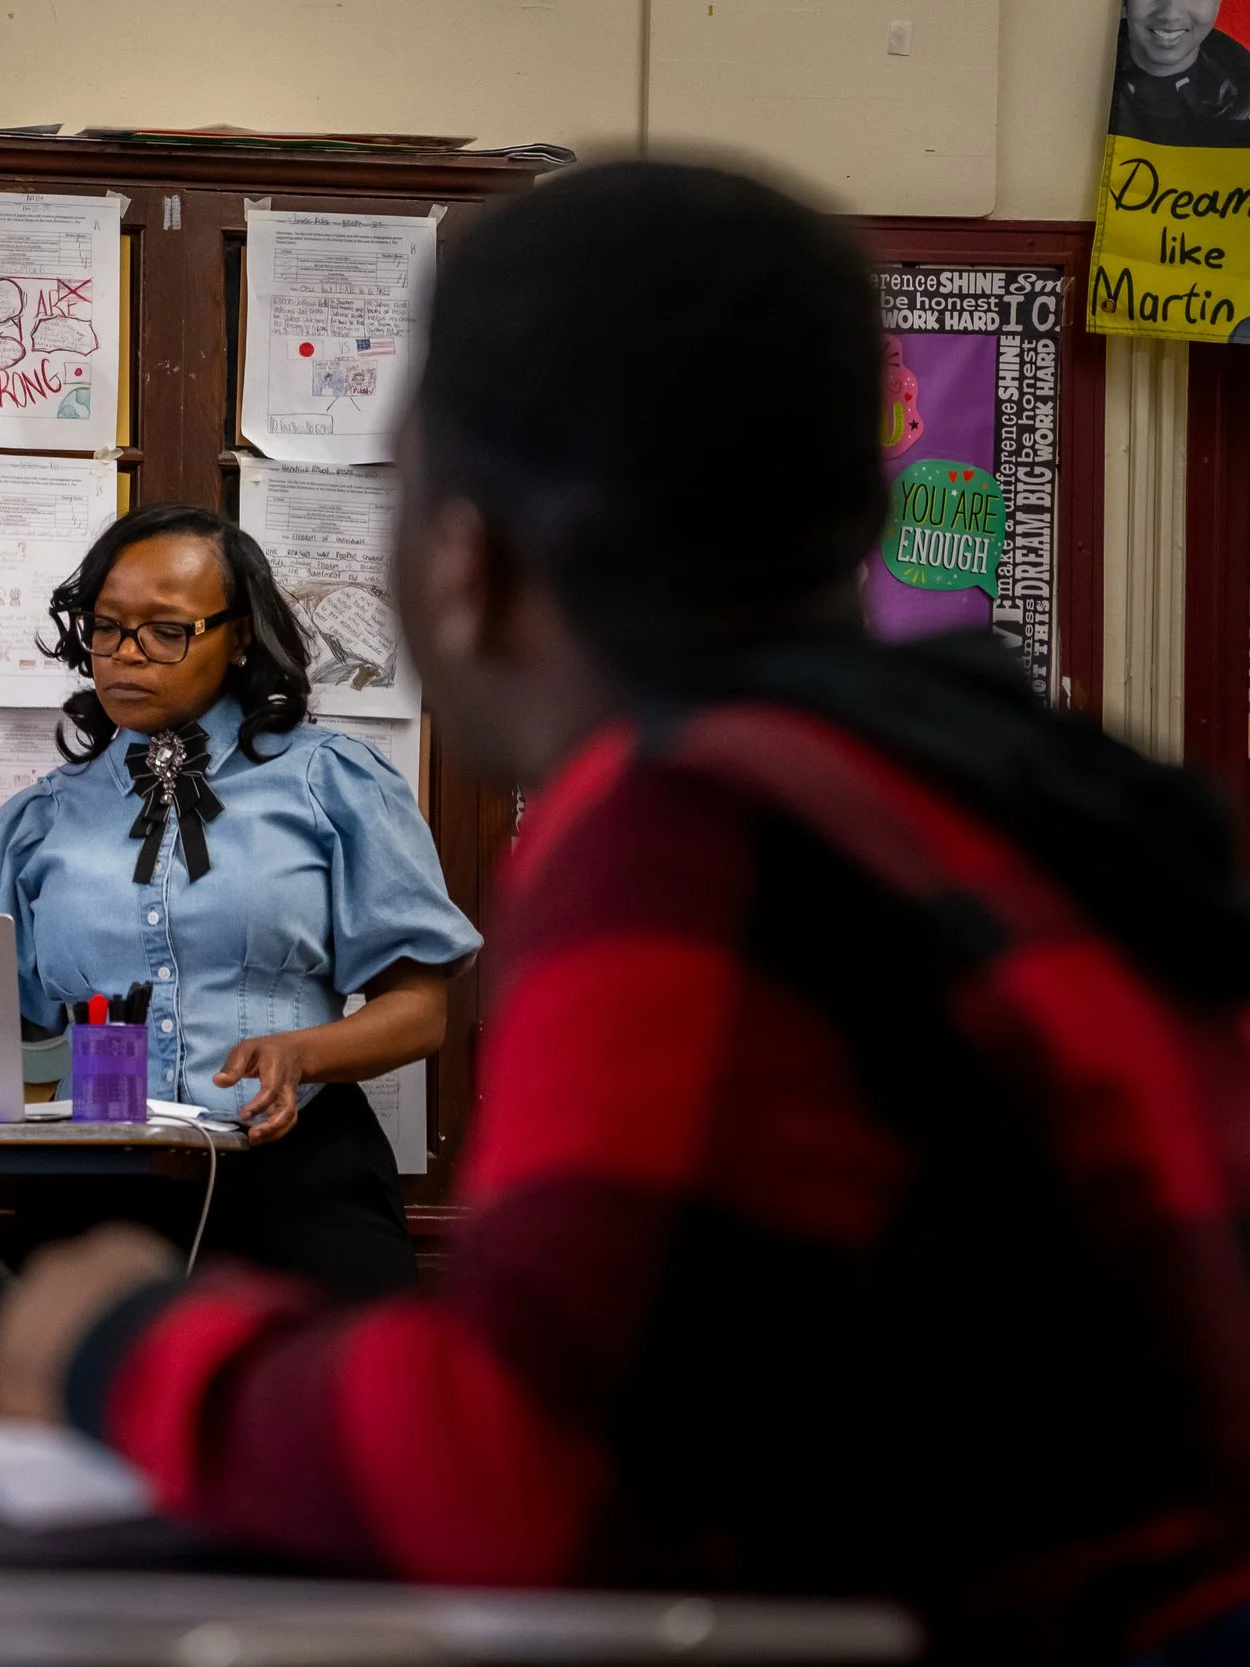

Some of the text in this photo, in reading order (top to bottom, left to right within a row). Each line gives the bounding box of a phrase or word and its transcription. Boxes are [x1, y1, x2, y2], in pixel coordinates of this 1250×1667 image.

[1109, 157, 1250, 220] Dream
[1159, 226, 1226, 269] like
[880, 291, 999, 311] be honest
[939, 271, 1006, 295] SHINE
[1091, 265, 1235, 325] Martin
[881, 309, 1001, 332] WORK HARD
[998, 335, 1021, 401] SHINE
[1017, 339, 1036, 463] be honest
[1034, 338, 1056, 462] WORK HARD
[901, 480, 1000, 536] YOU ARE
[1014, 466, 1053, 598] DREAM BIG
[897, 525, 990, 574] ENOUGH
